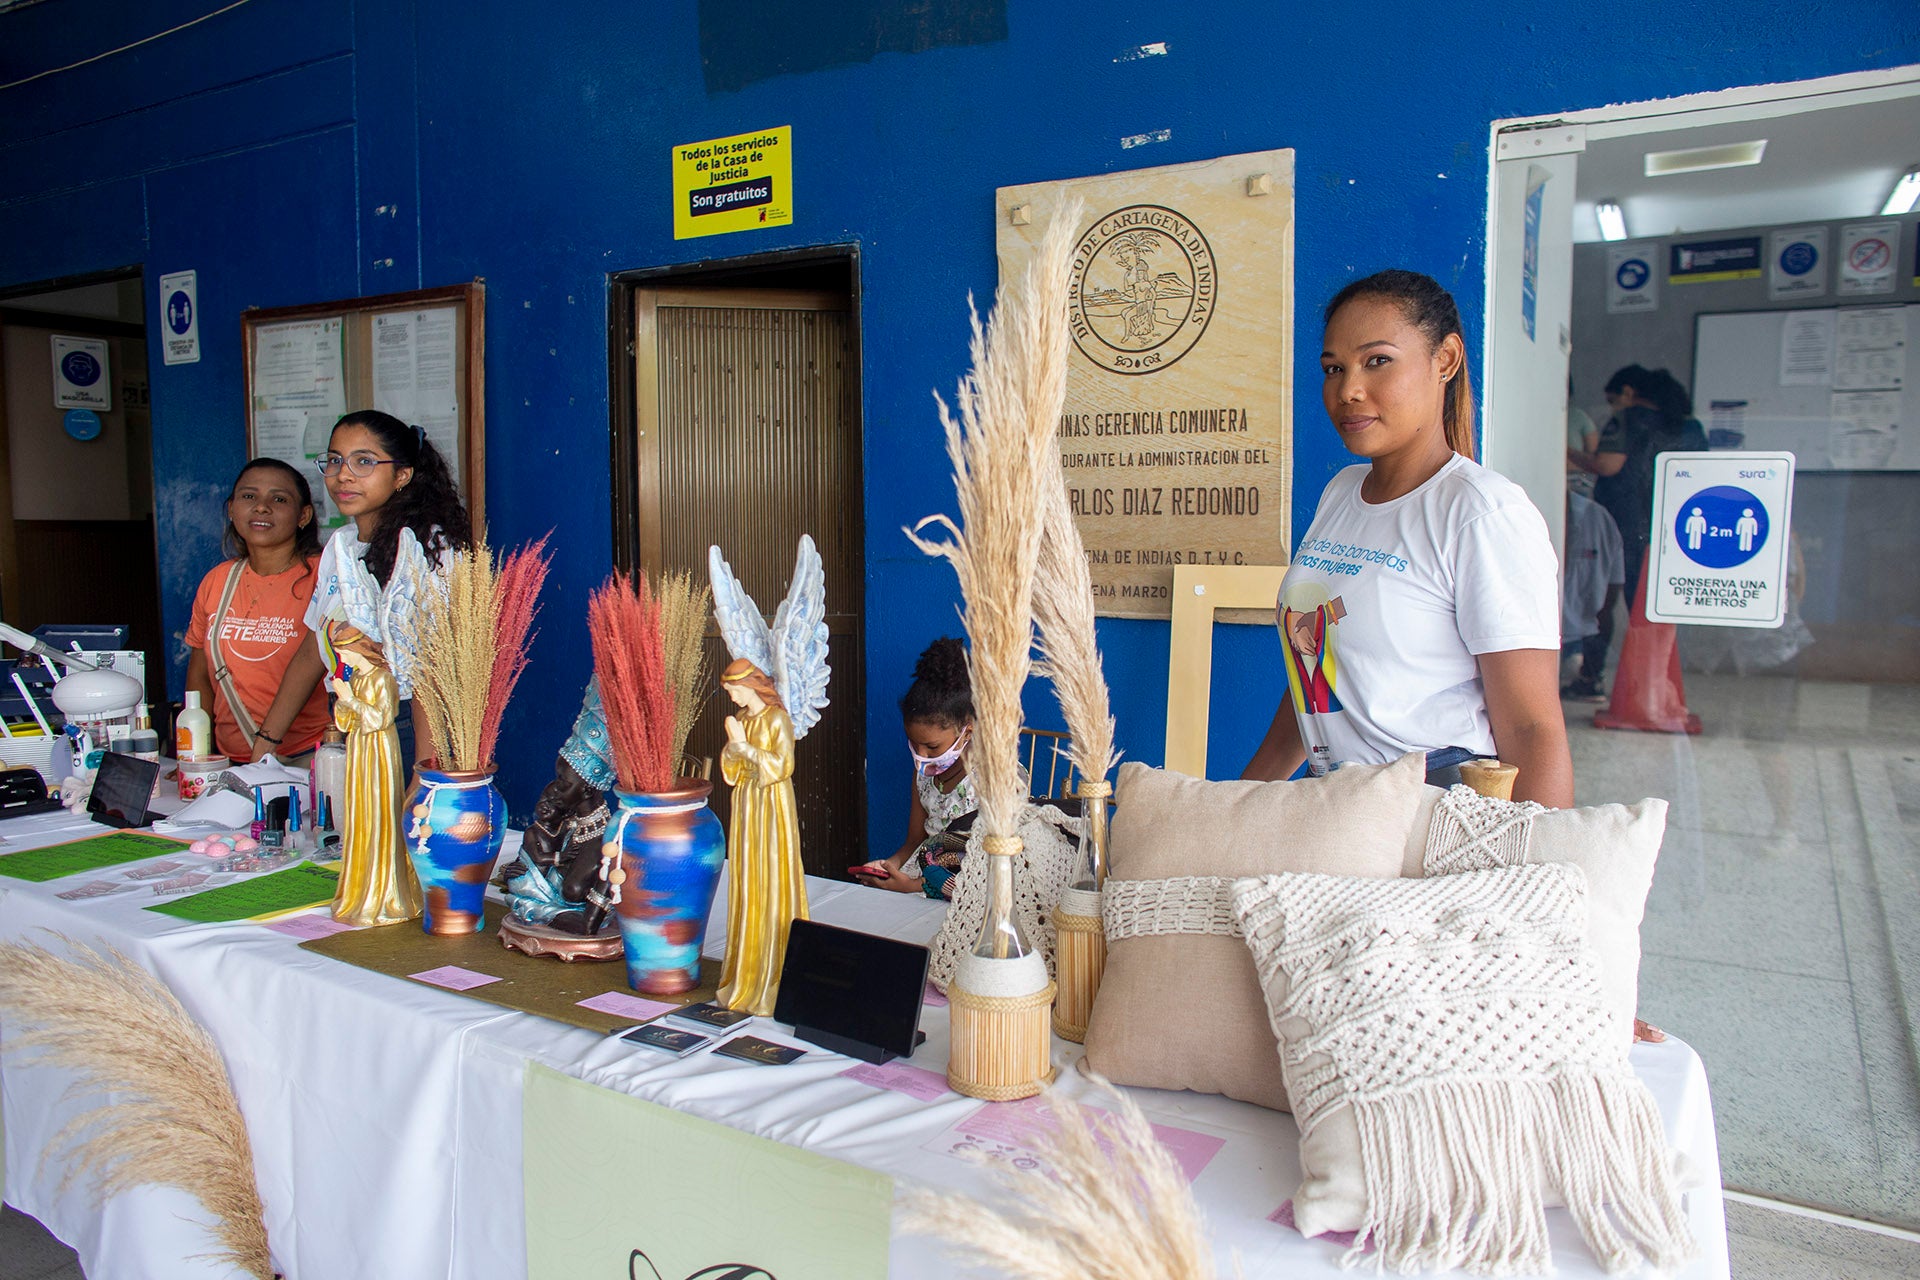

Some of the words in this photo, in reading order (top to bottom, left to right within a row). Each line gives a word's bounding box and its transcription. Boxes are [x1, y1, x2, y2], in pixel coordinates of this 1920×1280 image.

[681, 148, 711, 161] Todos
[714, 145, 729, 156] los
[731, 136, 778, 153] servicios
[696, 160, 708, 171] de
[711, 159, 720, 169] la
[723, 155, 747, 167] Casa
[750, 151, 763, 162] de
[709, 167, 749, 185] Justicia
[692, 195, 713, 208] Son
[715, 187, 768, 208] gratuitos
[1100, 211, 1190, 242] CARTAGENA
[1080, 233, 1101, 258] DE
[1186, 237, 1207, 262] DE
[1191, 263, 1211, 326] INDIAS
[1056, 414, 1090, 437] INAS
[1095, 411, 1163, 436] GERENCIA
[1169, 408, 1248, 433] COMUNERA
[1062, 453, 1115, 468] DURANTE
[1119, 452, 1134, 467] LA
[1138, 449, 1239, 467] ADMINISTRACION
[1245, 449, 1270, 464] DEL
[1739, 470, 1766, 479] sura
[1070, 488, 1114, 515] RLOS
[1123, 487, 1162, 515] DIAZ
[1172, 486, 1259, 515] REDONDO
[1084, 550, 1108, 564] ENA
[1115, 550, 1131, 564] DE
[1137, 550, 1182, 565] INDIAS
[1316, 558, 1363, 576] mujeres
[1344, 543, 1408, 573] banderas
[1091, 585, 1116, 597] ENA
[1122, 585, 1168, 598] MARZO
[1668, 577, 1737, 588] CONSERVA
[1740, 580, 1767, 589] UNA
[1674, 586, 1739, 597] DISTANCIA
[1743, 590, 1760, 599] DE
[1684, 597, 1691, 605] 2
[1695, 597, 1747, 608] METROS
[251, 635, 287, 644] MUJERES
[254, 628, 284, 636] CONTRA
